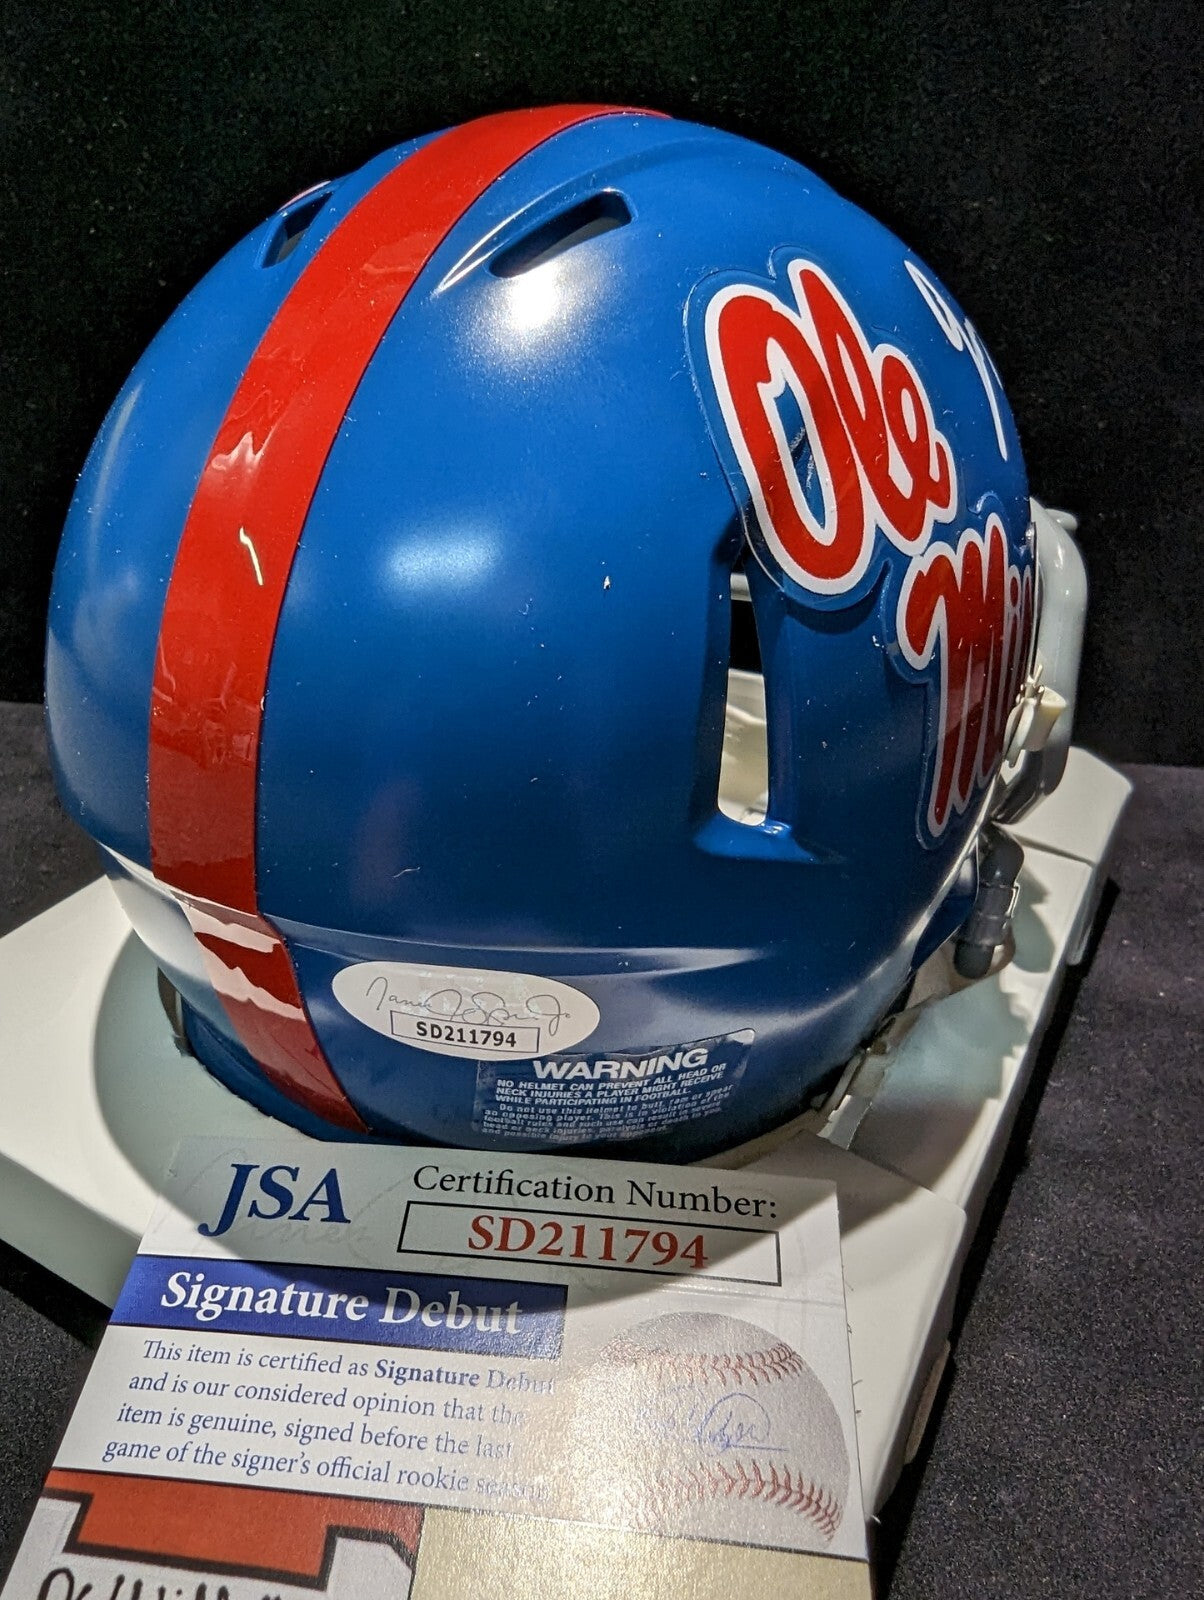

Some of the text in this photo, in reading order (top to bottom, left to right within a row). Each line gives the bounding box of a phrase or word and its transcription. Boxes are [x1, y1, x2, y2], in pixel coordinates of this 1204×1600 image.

[705, 259, 958, 596] Ole
[416, 1021, 516, 1048] SD211794
[496, 1071, 723, 1098] NECK INJURIES A PLAYER MIGHT RECEIVE
[519, 1081, 565, 1090] HELMET
[569, 1083, 593, 1091] CAN
[598, 1079, 651, 1090] PREVENT
[653, 1075, 673, 1085] ALL
[678, 1068, 708, 1080] HEAD
[710, 1063, 727, 1072] OR
[533, 1048, 708, 1079] WARNING
[495, 1095, 532, 1104] WHILE
[535, 1098, 616, 1106] PARTICIPATING
[634, 1088, 691, 1101] FOOTBALL.
[500, 1103, 513, 1112] Do
[517, 1105, 534, 1113] not
[539, 1107, 557, 1115] use
[561, 1107, 582, 1115] this
[502, 1111, 552, 1122] opposing
[652, 1102, 697, 1114] violation
[198, 1163, 352, 1237] JSA
[413, 1165, 779, 1219] Certification Number:
[468, 1214, 709, 1269] SD211794
[161, 1272, 522, 1336] Signature Debut
[143, 1340, 556, 1395] This item is certified as Signature Debut
[128, 1372, 525, 1426] and is our considered opinion that the
[117, 1403, 514, 1459] item is genuine, signed before the last
[102, 1440, 161, 1462] game
[166, 1441, 193, 1463] of
[193, 1442, 227, 1466] the
[231, 1448, 311, 1476] signer’s
[316, 1455, 391, 1483] official
[396, 1466, 469, 1491] rookie
